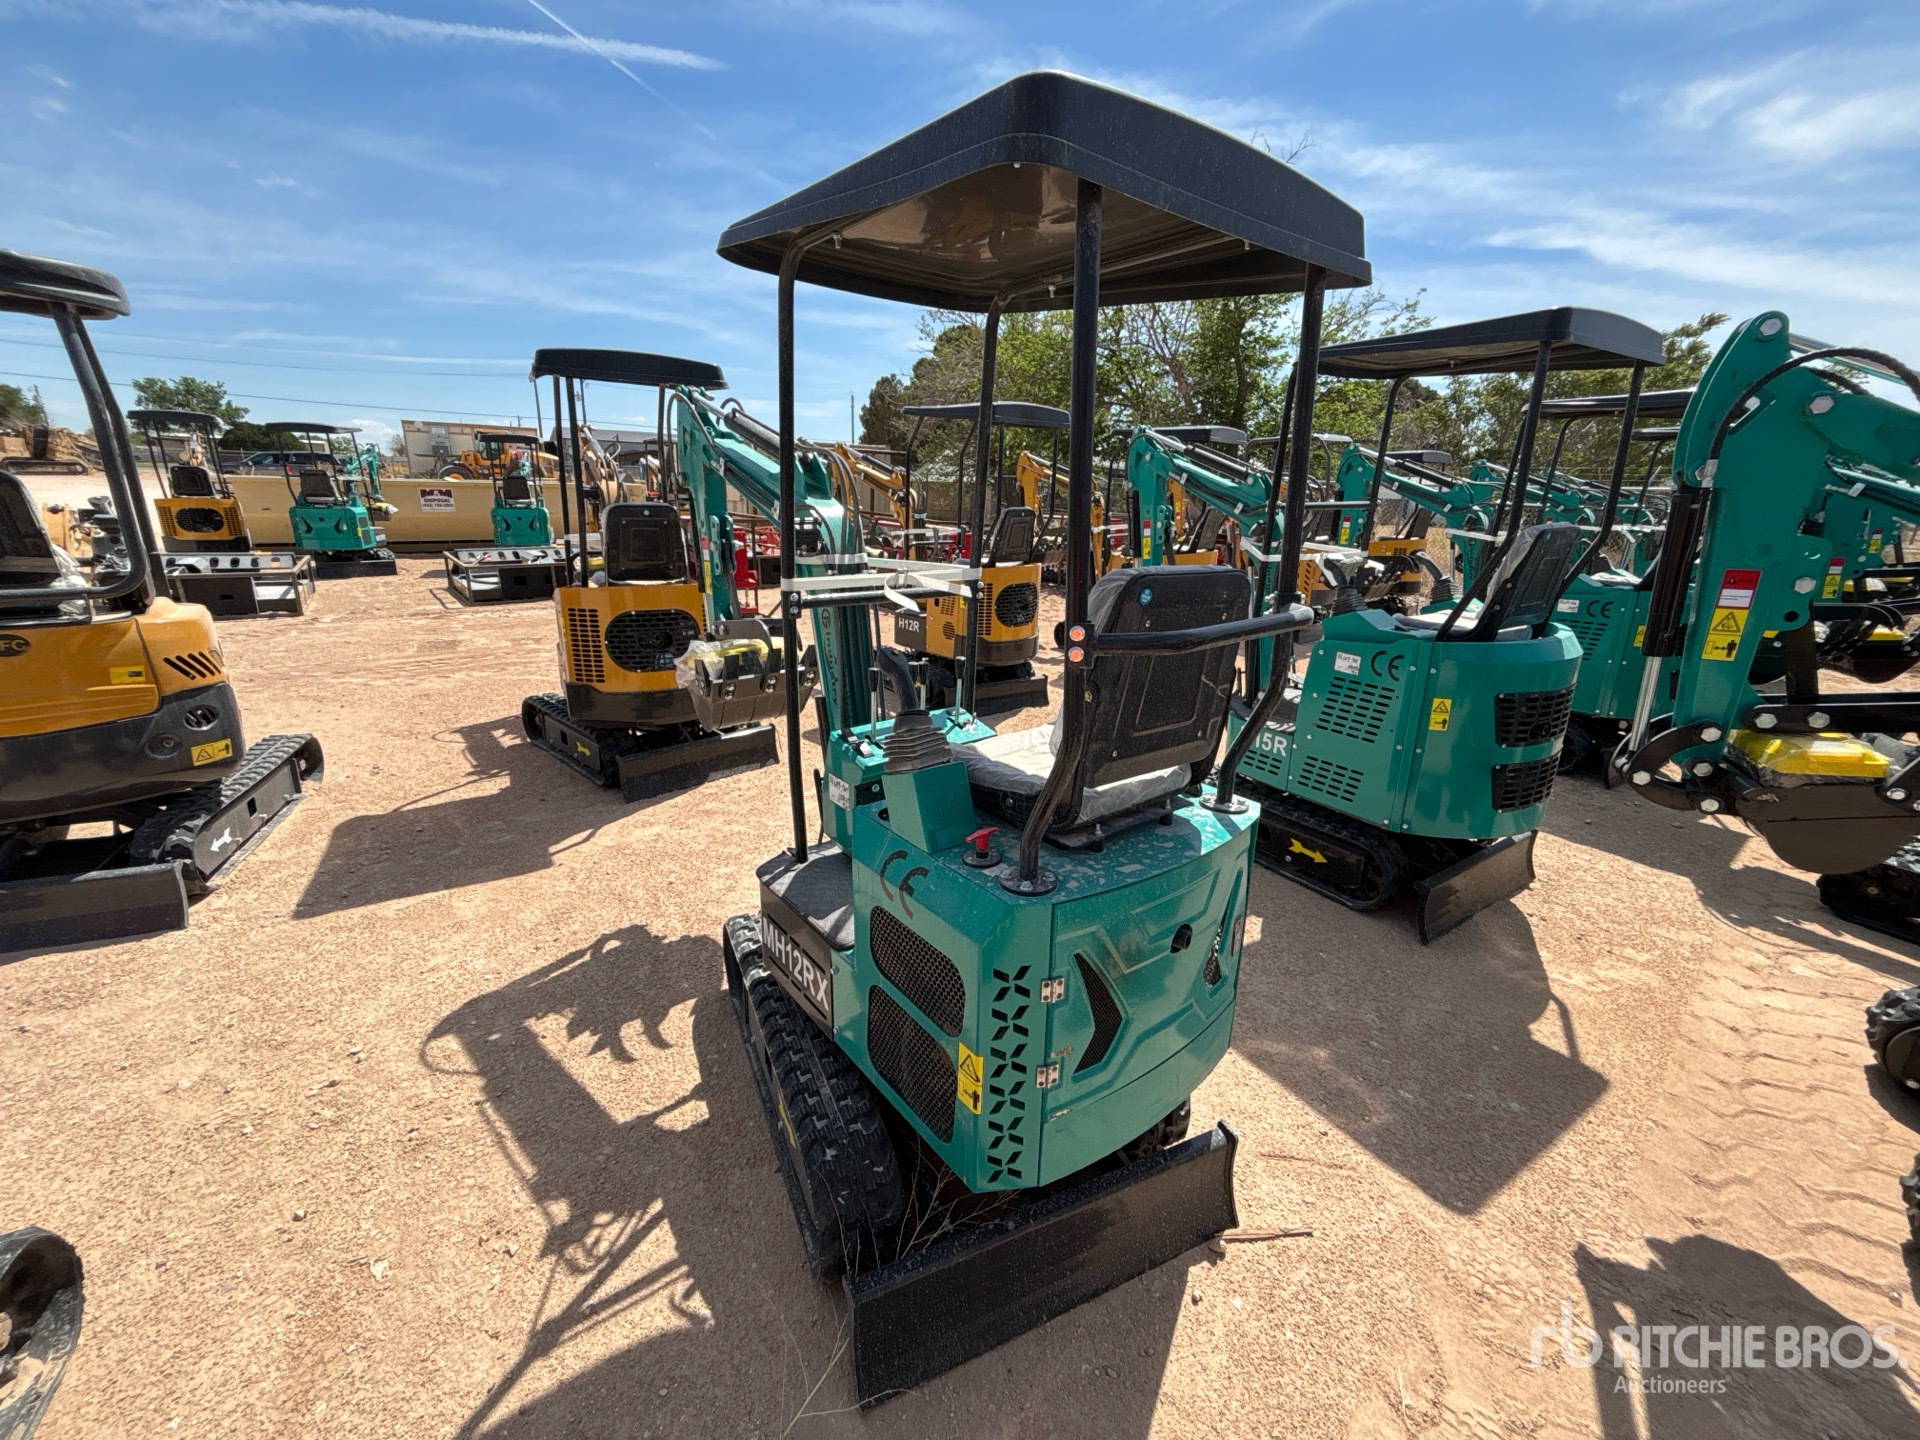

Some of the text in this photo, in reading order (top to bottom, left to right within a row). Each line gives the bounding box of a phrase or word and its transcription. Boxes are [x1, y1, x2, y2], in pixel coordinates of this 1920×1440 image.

[1586, 600, 1614, 619] CE
[898, 617, 920, 632] H12R
[1371, 650, 1405, 682] CE
[1255, 732, 1288, 757] 15R
[879, 850, 929, 920] CE
[762, 916, 829, 1011] MH12RX
